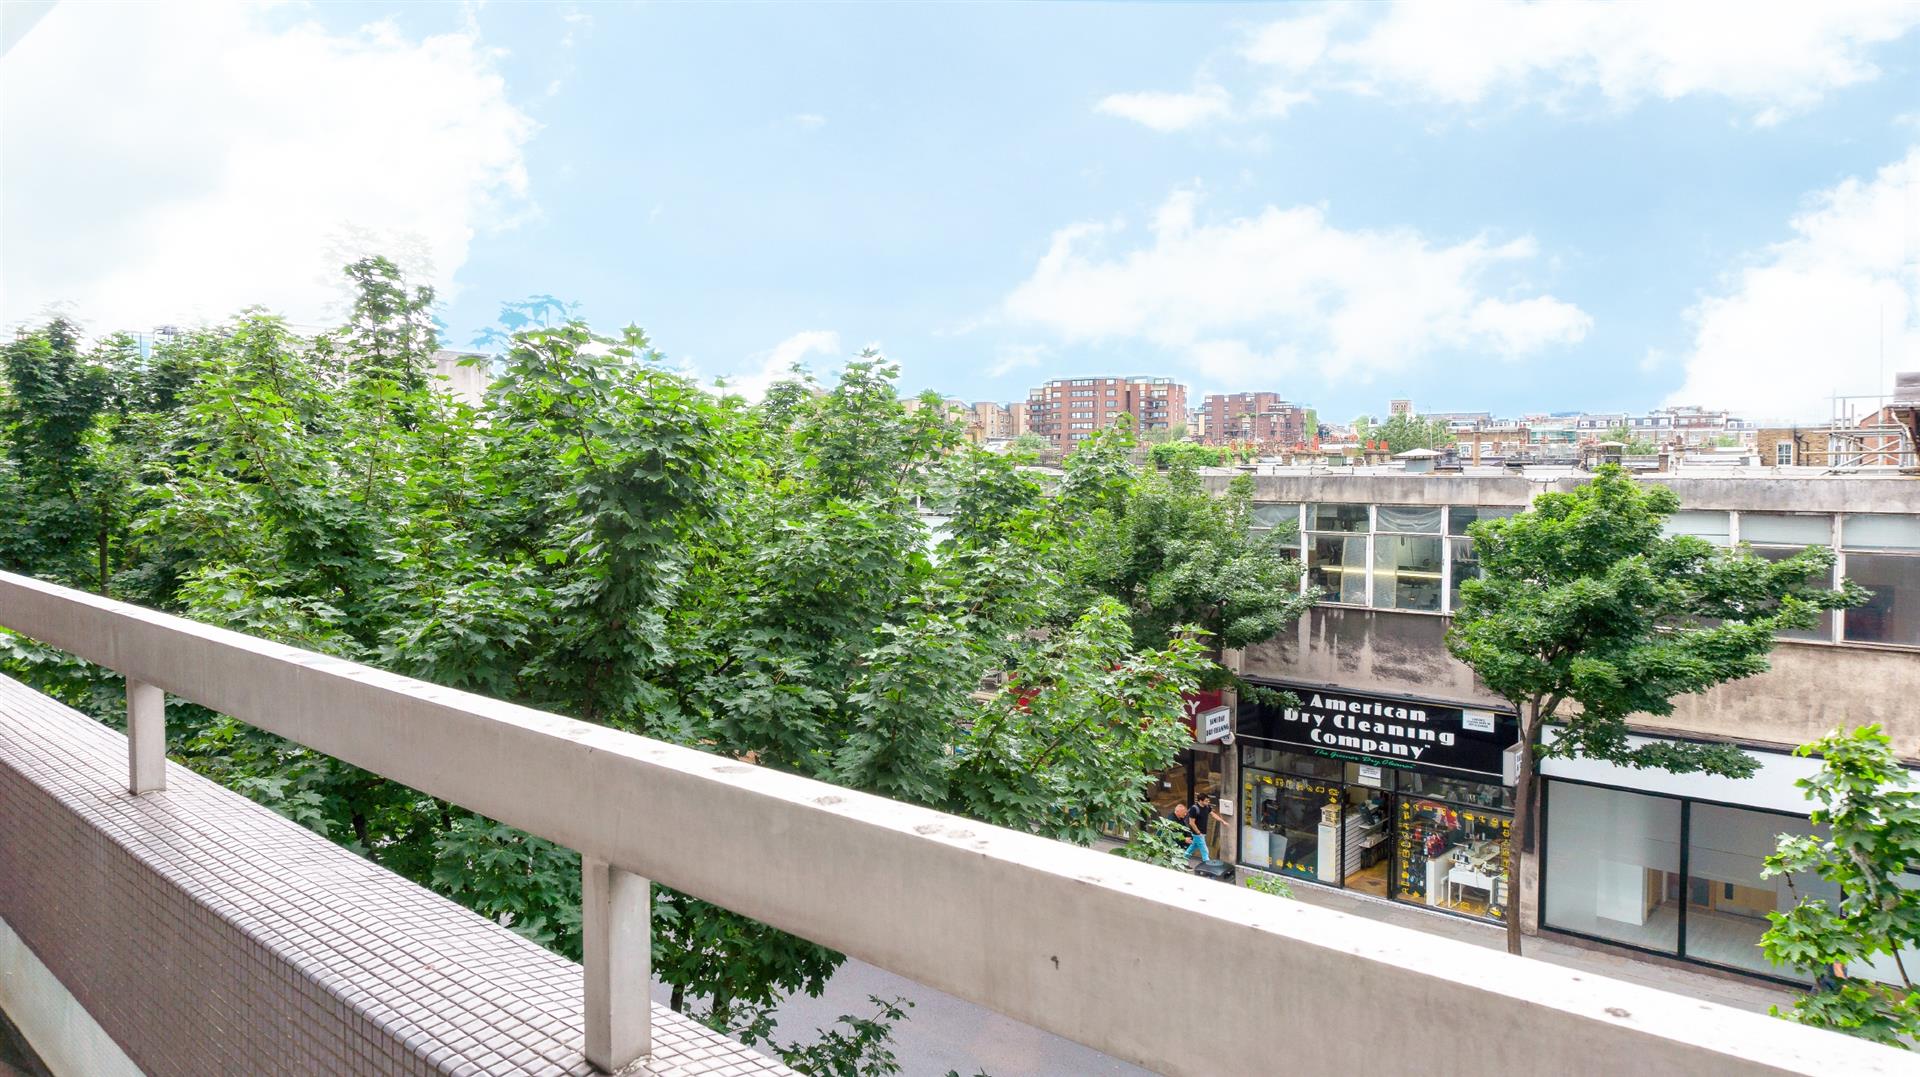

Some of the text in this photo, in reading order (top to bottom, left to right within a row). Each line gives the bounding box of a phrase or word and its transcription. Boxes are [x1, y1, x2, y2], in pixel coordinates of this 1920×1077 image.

[1310, 694, 1426, 722] American
[1284, 708, 1325, 727] Dry
[1333, 714, 1455, 746] Cleaning
[1311, 728, 1424, 760] Company
[1362, 756, 1380, 766] Dry
